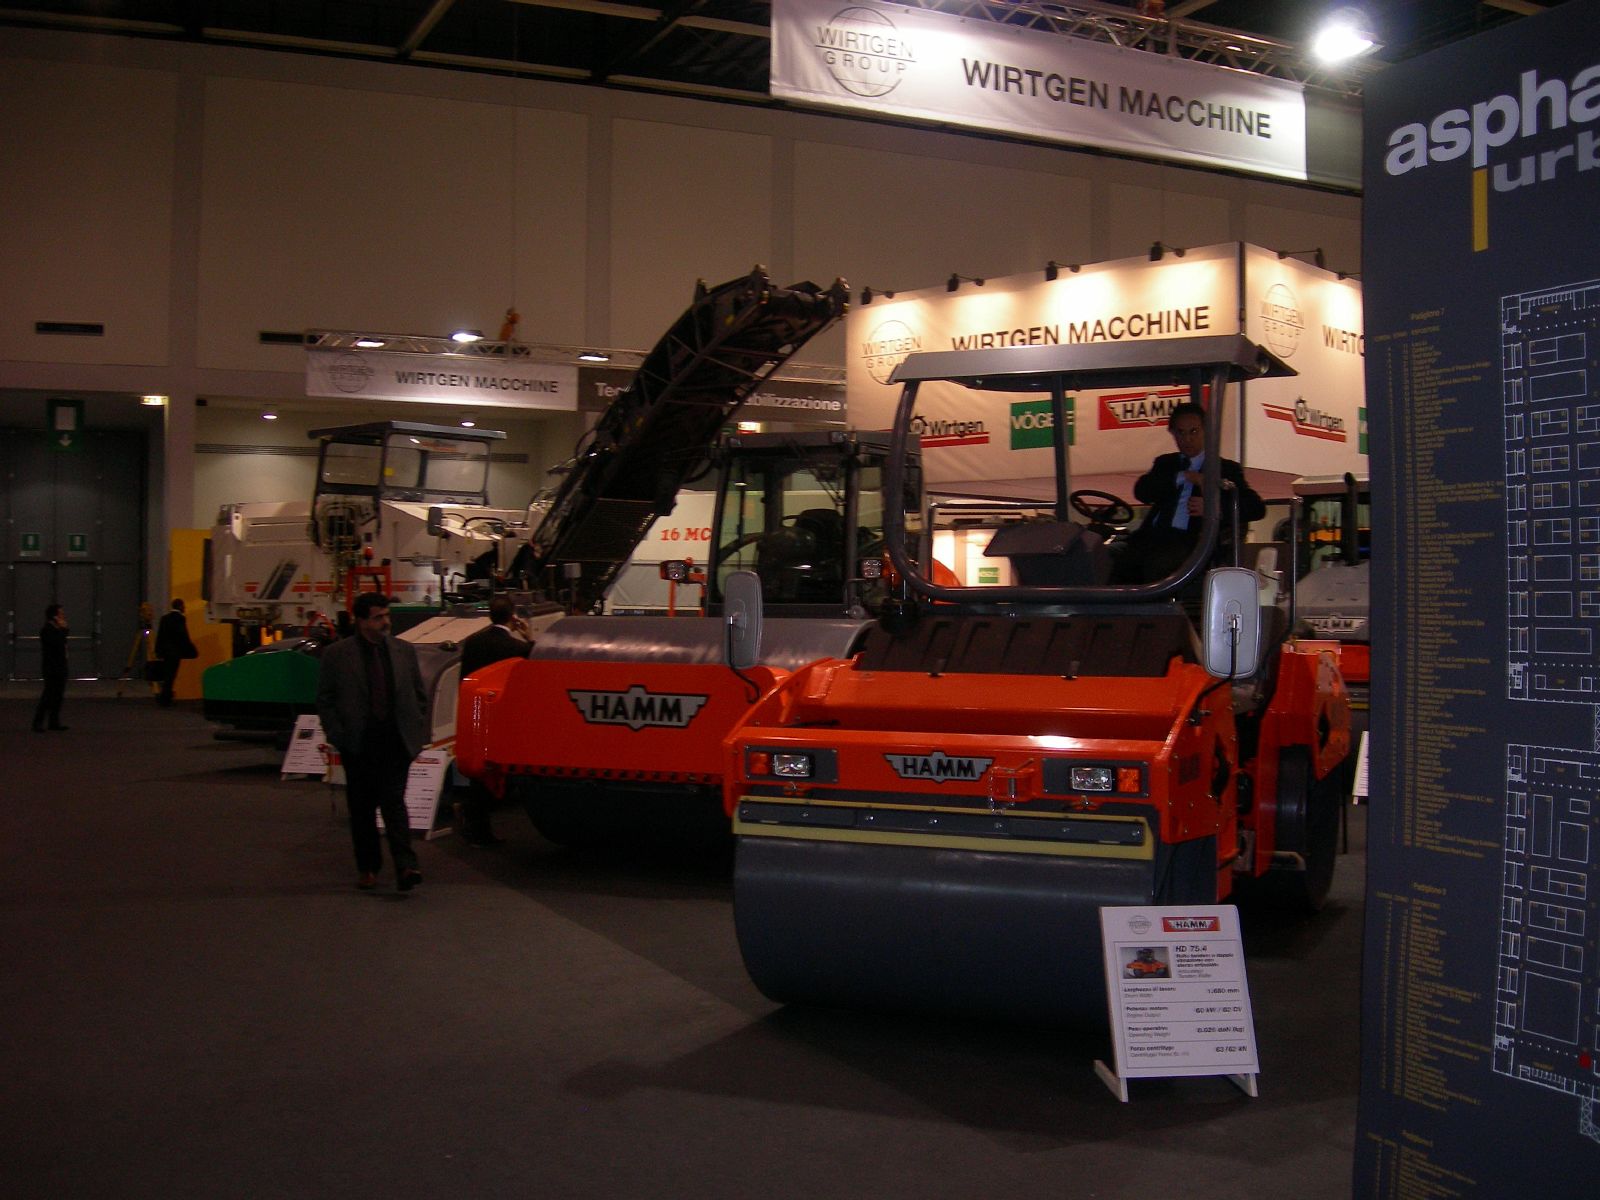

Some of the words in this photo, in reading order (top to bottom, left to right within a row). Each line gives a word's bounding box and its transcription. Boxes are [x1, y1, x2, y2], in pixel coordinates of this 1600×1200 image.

[817, 26, 913, 57] WIRTGEN
[824, 50, 907, 74] GROUP
[962, 58, 1110, 109] WIRTGEN
[1120, 86, 1272, 139] MACCHINE
[1069, 305, 1210, 344] MACCHINE
[395, 370, 470, 387] WIRTGEN
[474, 376, 559, 393] MACCHINE
[928, 419, 984, 438] Wirtgen
[1011, 409, 1074, 430] VÖGEE
[1307, 408, 1345, 432] Wirtgen
[660, 527, 680, 541] 16
[591, 695, 682, 722] HAMM
[903, 757, 976, 778] HAMM
[1175, 919, 1208, 929] HAMM
[1175, 945, 1187, 953] HD
